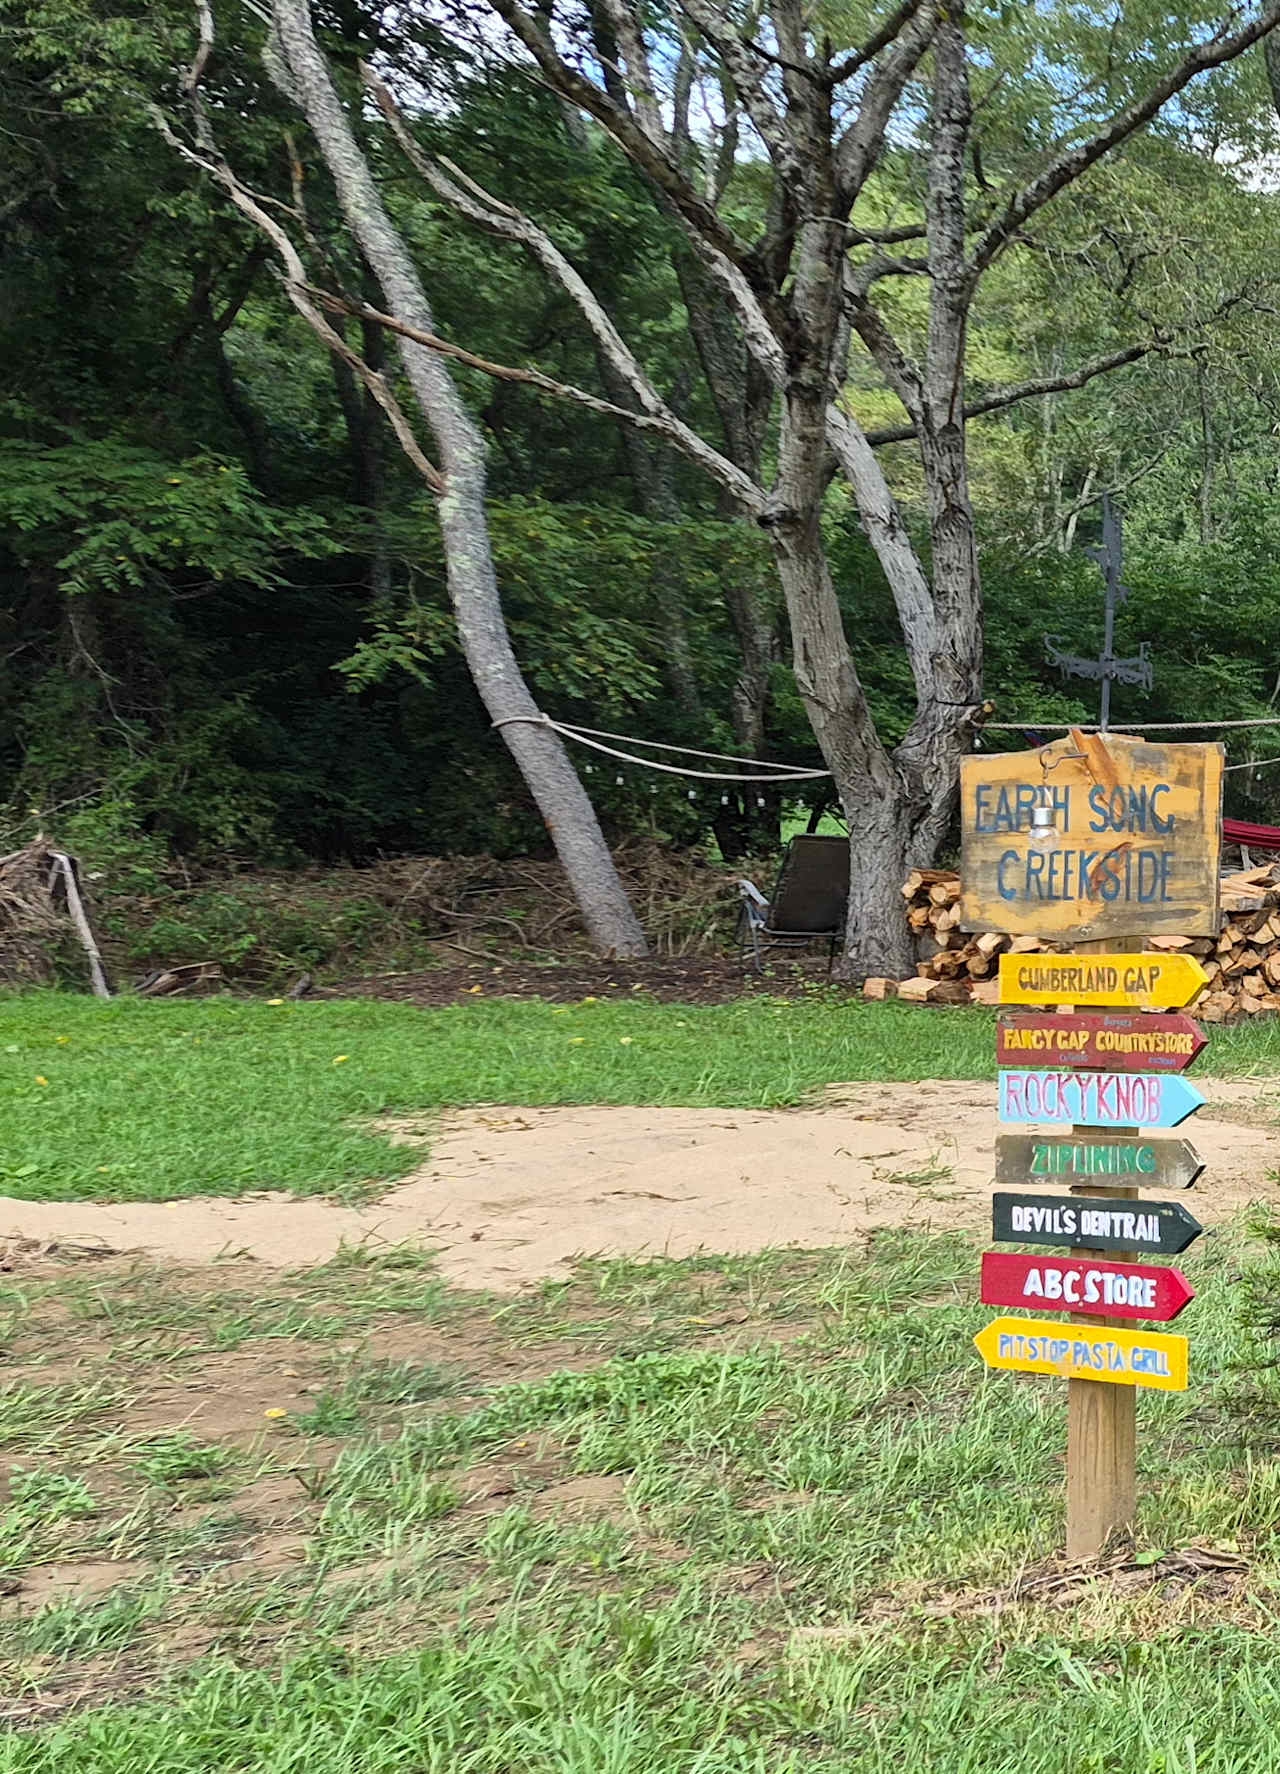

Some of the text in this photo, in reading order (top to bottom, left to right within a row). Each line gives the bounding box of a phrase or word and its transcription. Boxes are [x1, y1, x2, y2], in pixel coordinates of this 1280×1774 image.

[975, 783, 1175, 834] EARTH SONG
[997, 849, 1177, 903] CREEKSIDE
[1018, 966, 1161, 993] CUMBERLAND GAP
[1004, 1029, 1057, 1050] FANCY
[1057, 1030, 1090, 1050] GAP
[1030, 1145, 1157, 1175] ZIPLINING
[1011, 1205, 1077, 1235] DEVIL'S
[1022, 1268, 1157, 1308] ABC STORE
[1071, 1340, 1125, 1372] PASTA
[1130, 1346, 1172, 1378] GRILL
